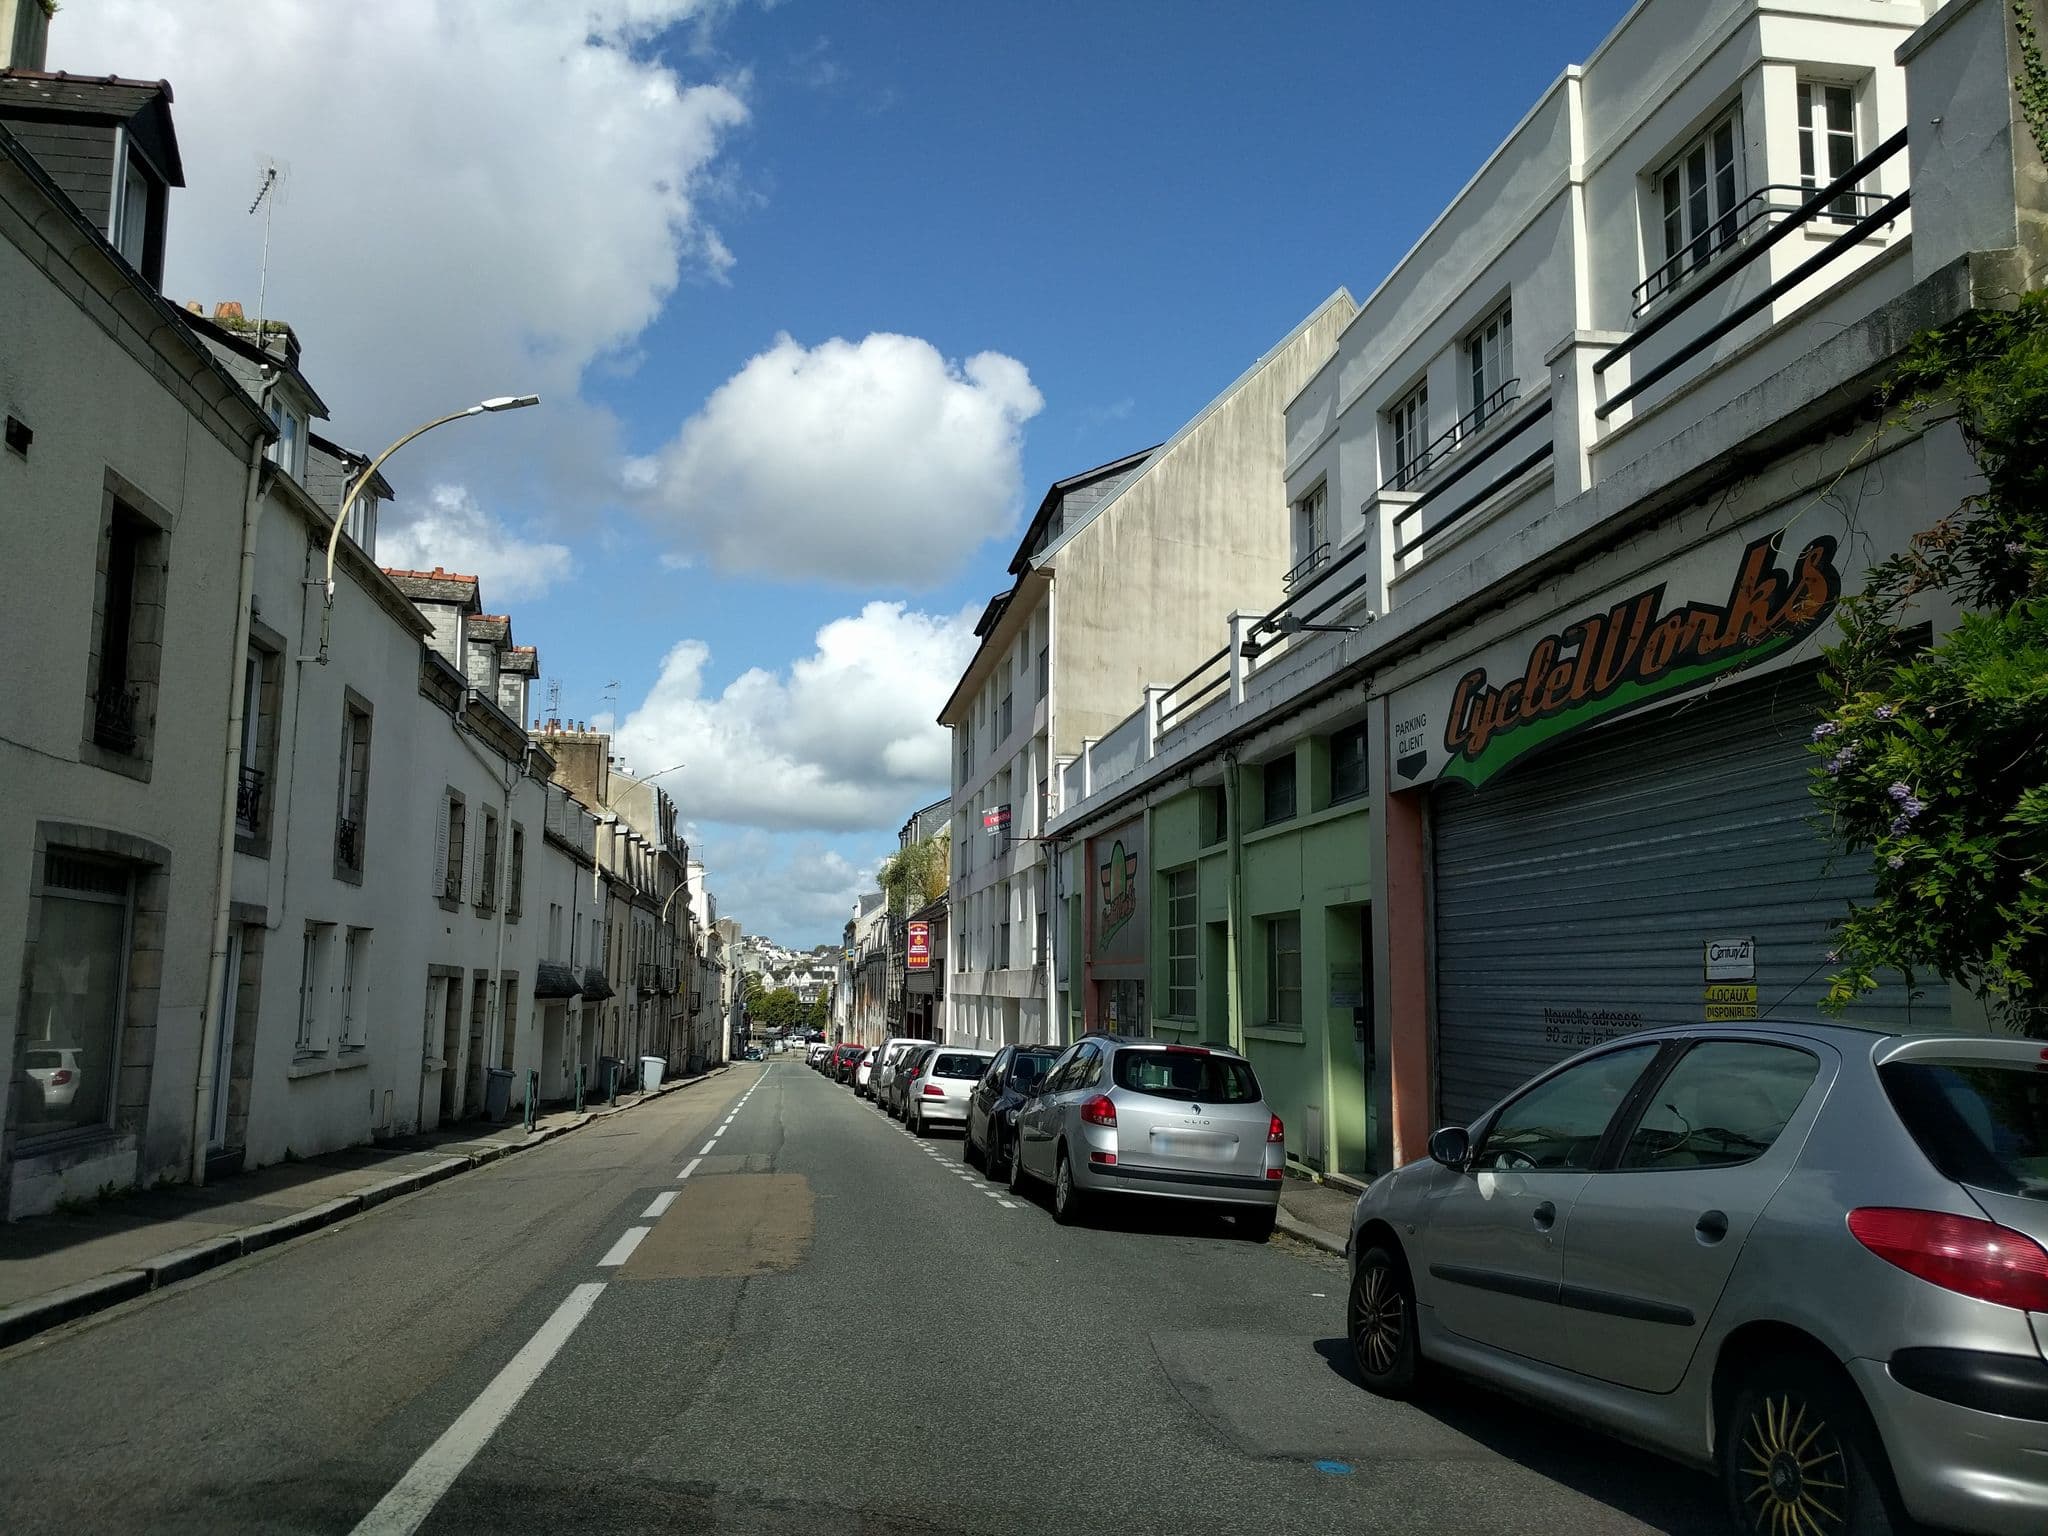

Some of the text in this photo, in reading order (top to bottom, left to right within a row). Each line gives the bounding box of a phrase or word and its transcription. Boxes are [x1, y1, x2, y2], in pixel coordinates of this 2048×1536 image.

[1395, 713, 1427, 737] PARKING
[1398, 733, 1424, 754] CLIENT
[1712, 987, 1750, 1002] LOCAUX
[1544, 1008, 1643, 1028] Nouvelle adresse:
[1706, 1006, 1757, 1018] DISPONIBLES
[1545, 1026, 1560, 1042] 90
[1561, 1032, 1573, 1044] av
[1576, 1027, 1590, 1045] de
